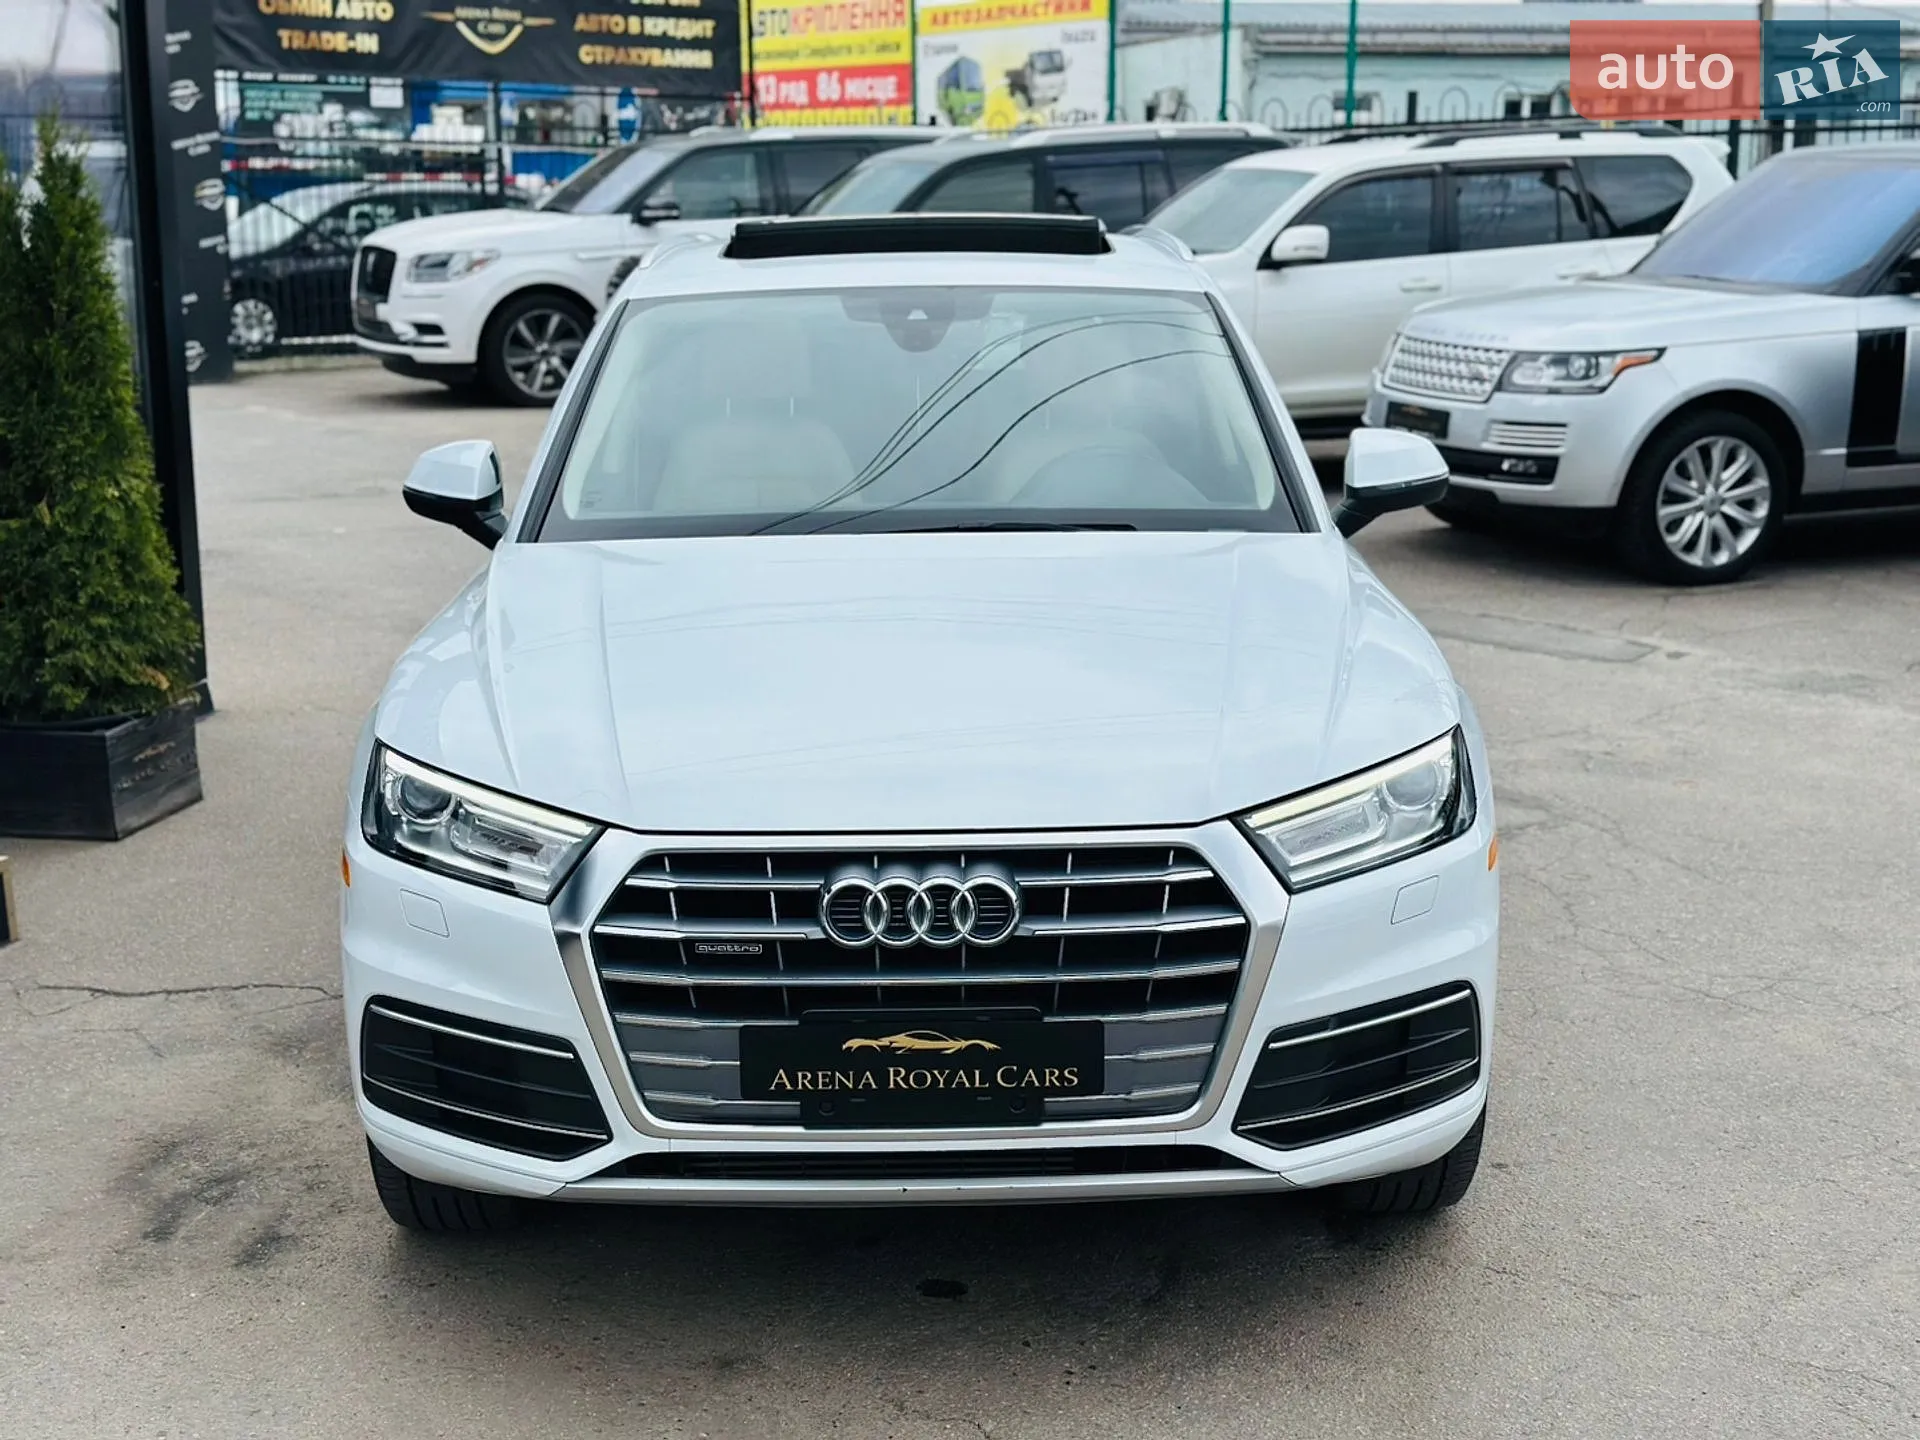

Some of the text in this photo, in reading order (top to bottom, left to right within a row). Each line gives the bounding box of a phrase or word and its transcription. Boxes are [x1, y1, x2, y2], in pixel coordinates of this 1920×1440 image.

[335, 0, 395, 22] АВТО
[930, 0, 1093, 27] АВТОЗАПЧАСТИНИ
[573, 12, 716, 41] АВТО В КРЕДИТ
[277, 28, 380, 54] TRADE-IN
[578, 43, 713, 69] СТРАХУВАННЯ
[816, 70, 841, 101] 86
[768, 1065, 1080, 1091] ARENA ROYAL CARS
